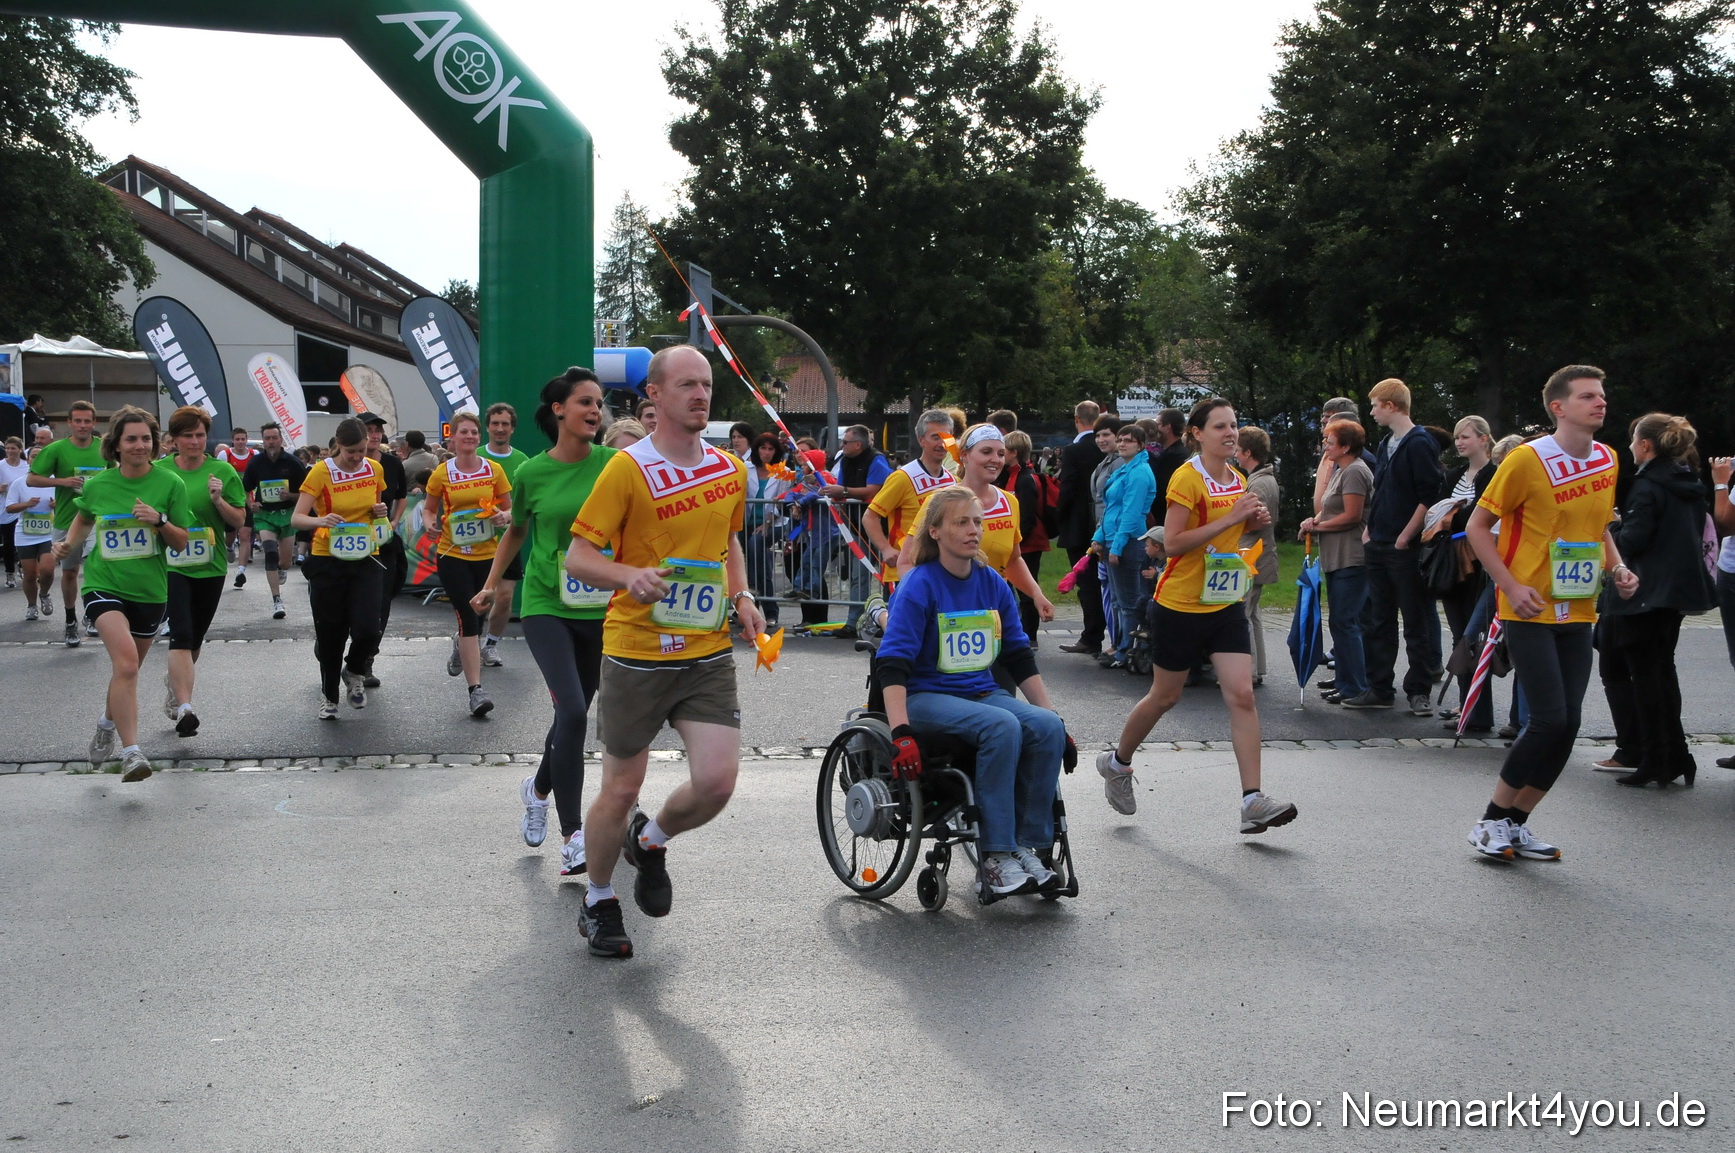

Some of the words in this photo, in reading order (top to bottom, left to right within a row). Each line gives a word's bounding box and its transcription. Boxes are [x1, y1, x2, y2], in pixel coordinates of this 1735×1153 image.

[376, 11, 548, 152] AOK
[261, 486, 285, 498] 113
[333, 485, 353, 493] MAX
[355, 479, 377, 489] BÖGL
[473, 480, 496, 488] BÖGL
[656, 495, 700, 521] MAX
[703, 480, 741, 505] BÖGL
[1554, 483, 1589, 505] MAX
[1211, 499, 1231, 509] MAX
[24, 518, 51, 530] 1030
[455, 520, 486, 538] 451
[988, 519, 1014, 531] BÖGL
[104, 528, 148, 549] 814
[333, 536, 368, 552] 435
[1206, 570, 1240, 591] 421
[1556, 561, 1594, 584] 443
[660, 582, 716, 613] 416
[664, 609, 692, 619] Andreas
[945, 630, 987, 658] 169
